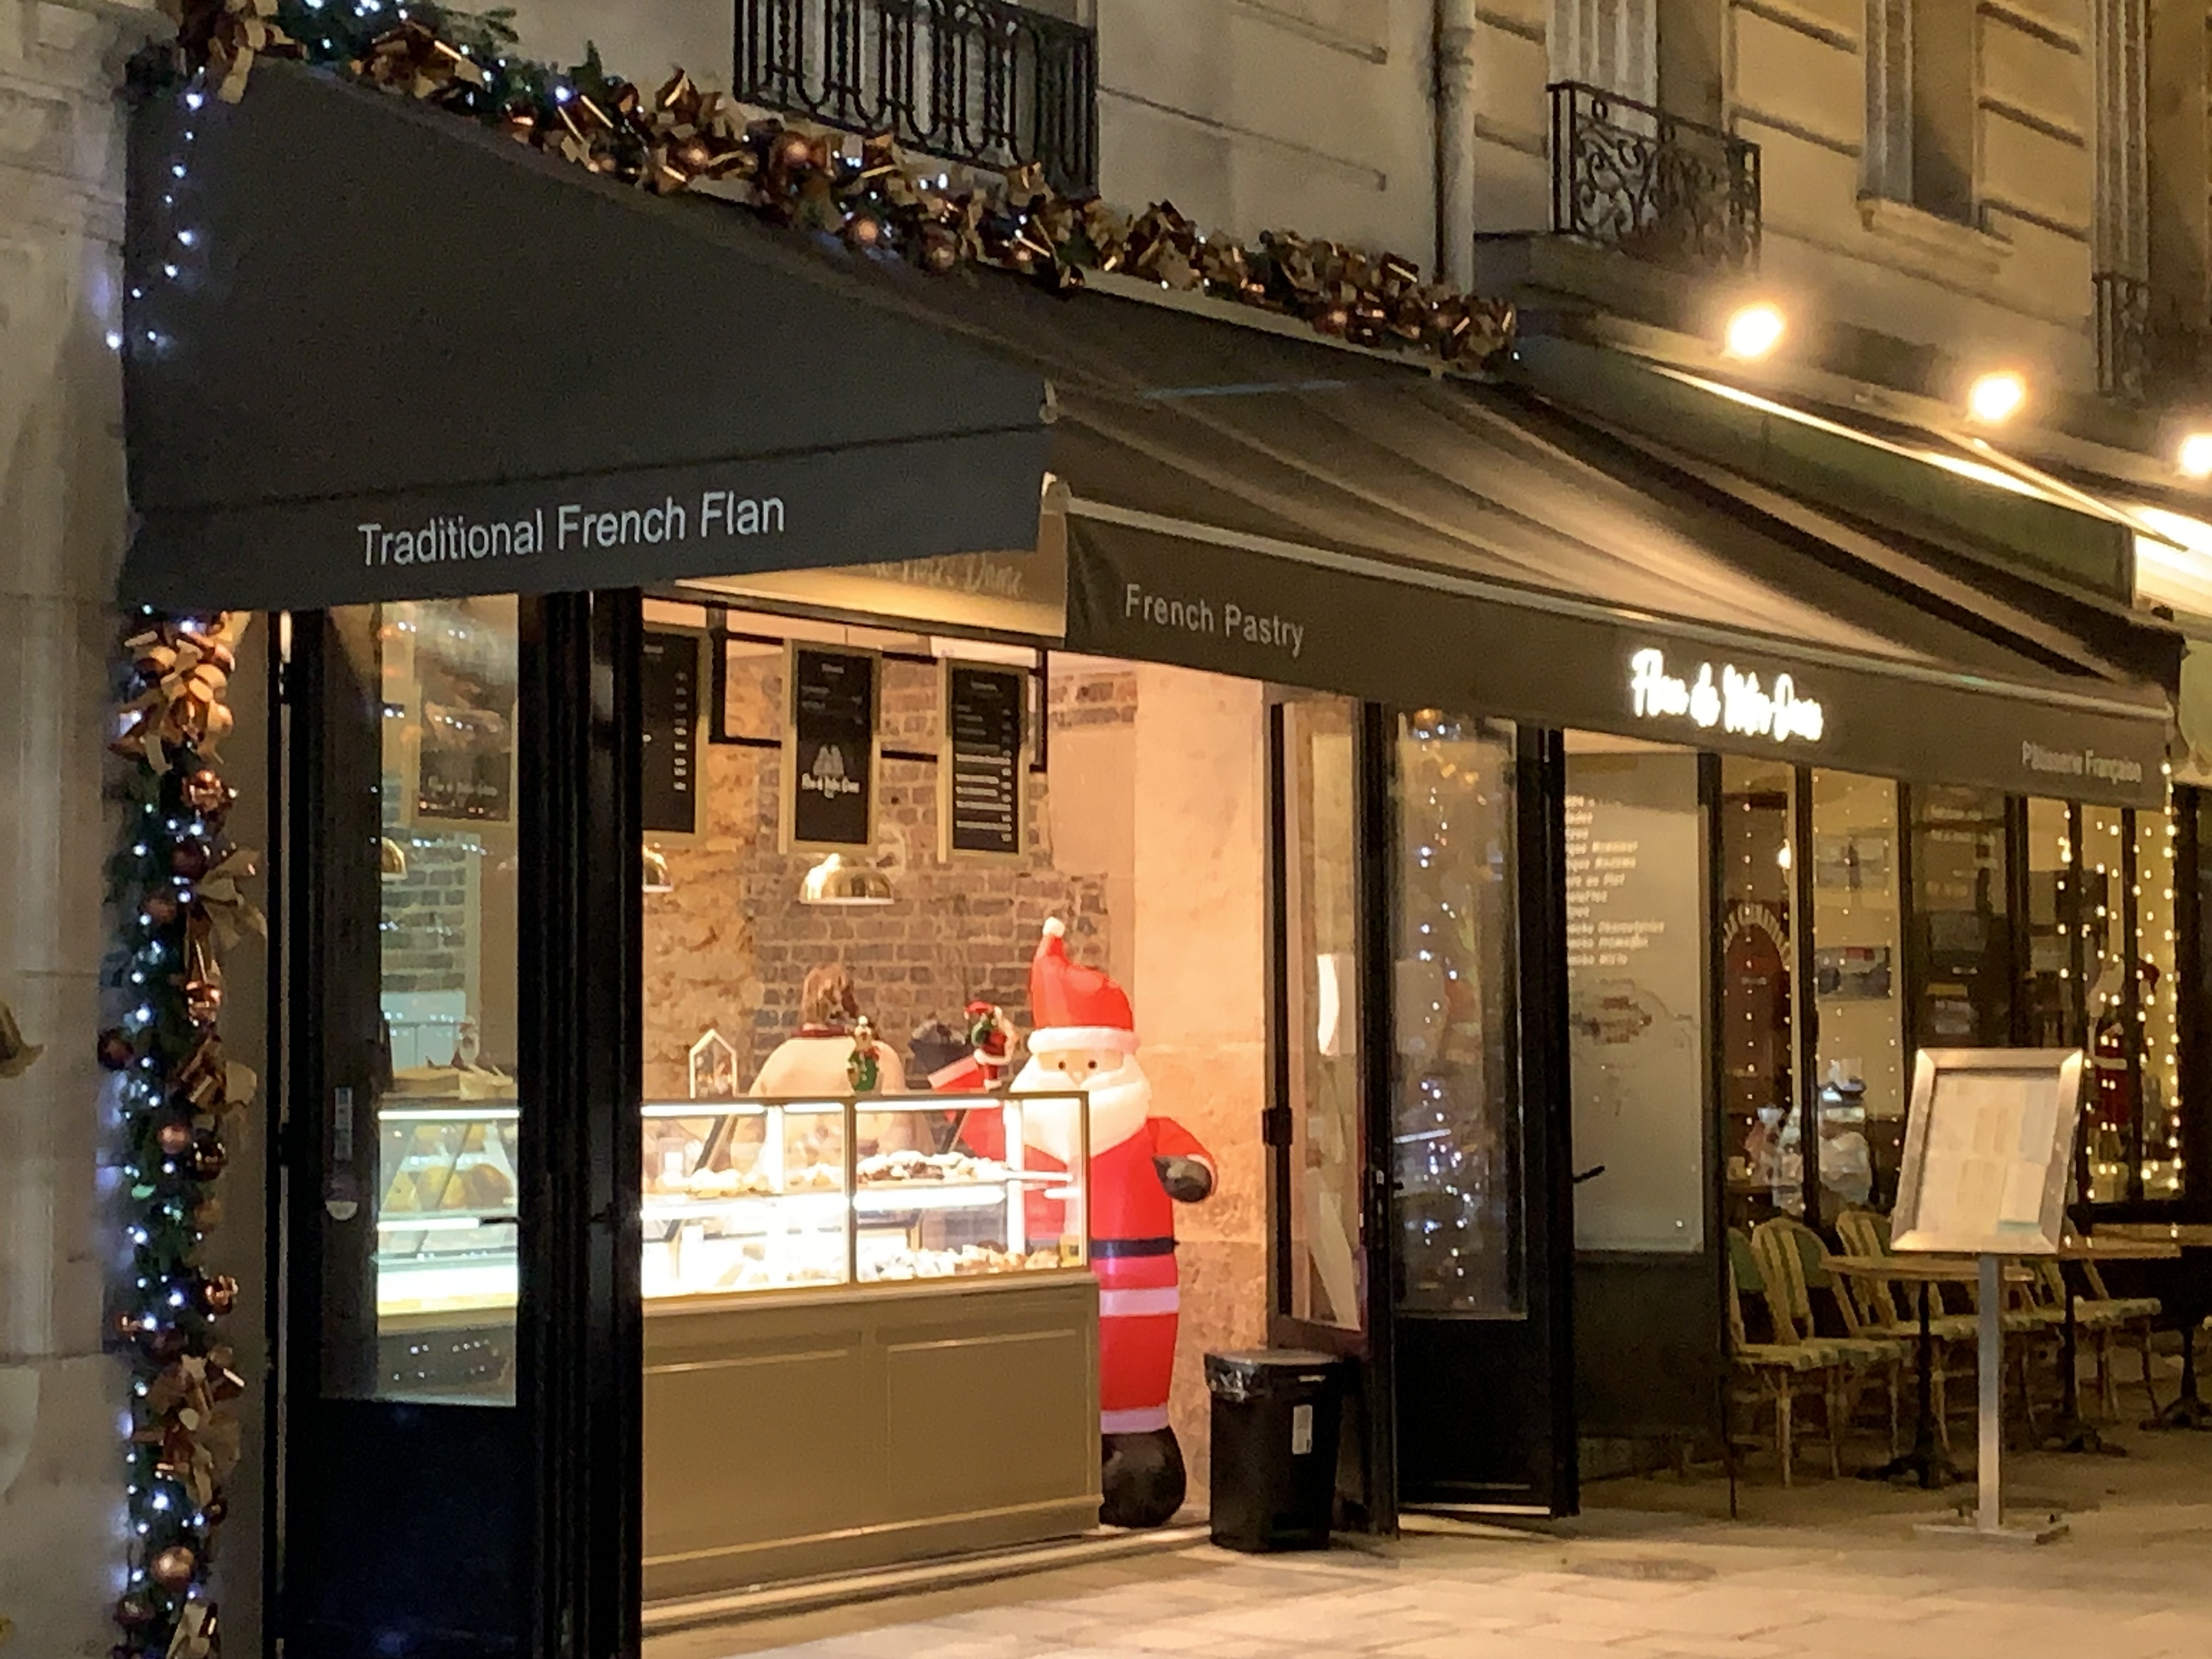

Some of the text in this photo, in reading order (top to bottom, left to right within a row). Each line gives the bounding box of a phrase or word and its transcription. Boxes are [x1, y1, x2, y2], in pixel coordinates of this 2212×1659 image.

[357, 489, 785, 567] Traditional French Flan
[1126, 583, 1304, 658] French Pastry
